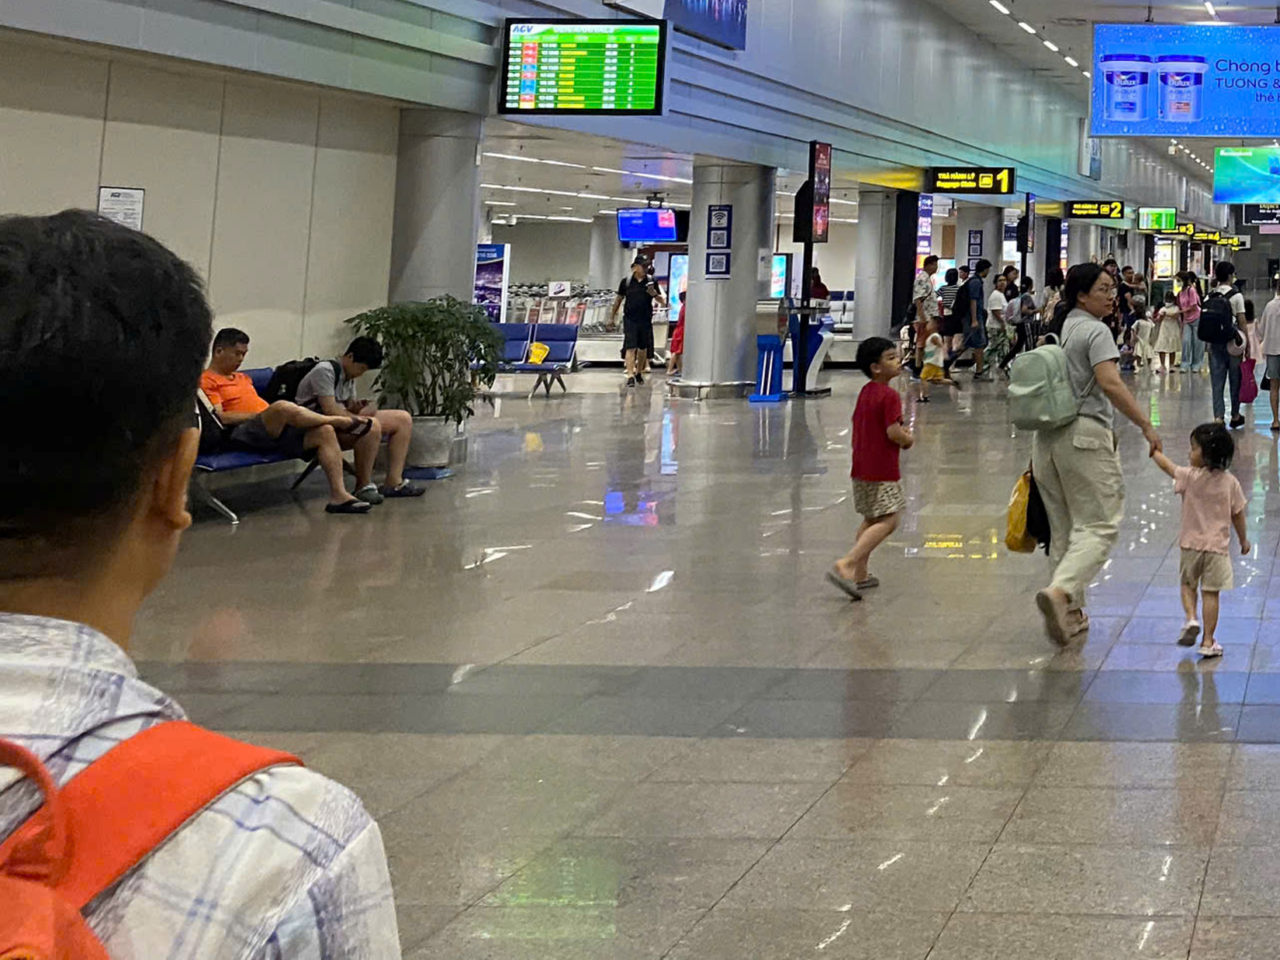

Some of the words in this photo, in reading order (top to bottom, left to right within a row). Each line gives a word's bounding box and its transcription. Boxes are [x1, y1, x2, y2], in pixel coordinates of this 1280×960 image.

[512, 25, 534, 33] ACV
[996, 169, 1008, 193] 1
[1110, 202, 1121, 217] 2
[1186, 224, 1194, 235] 3
[1212, 231, 1220, 241] 4
